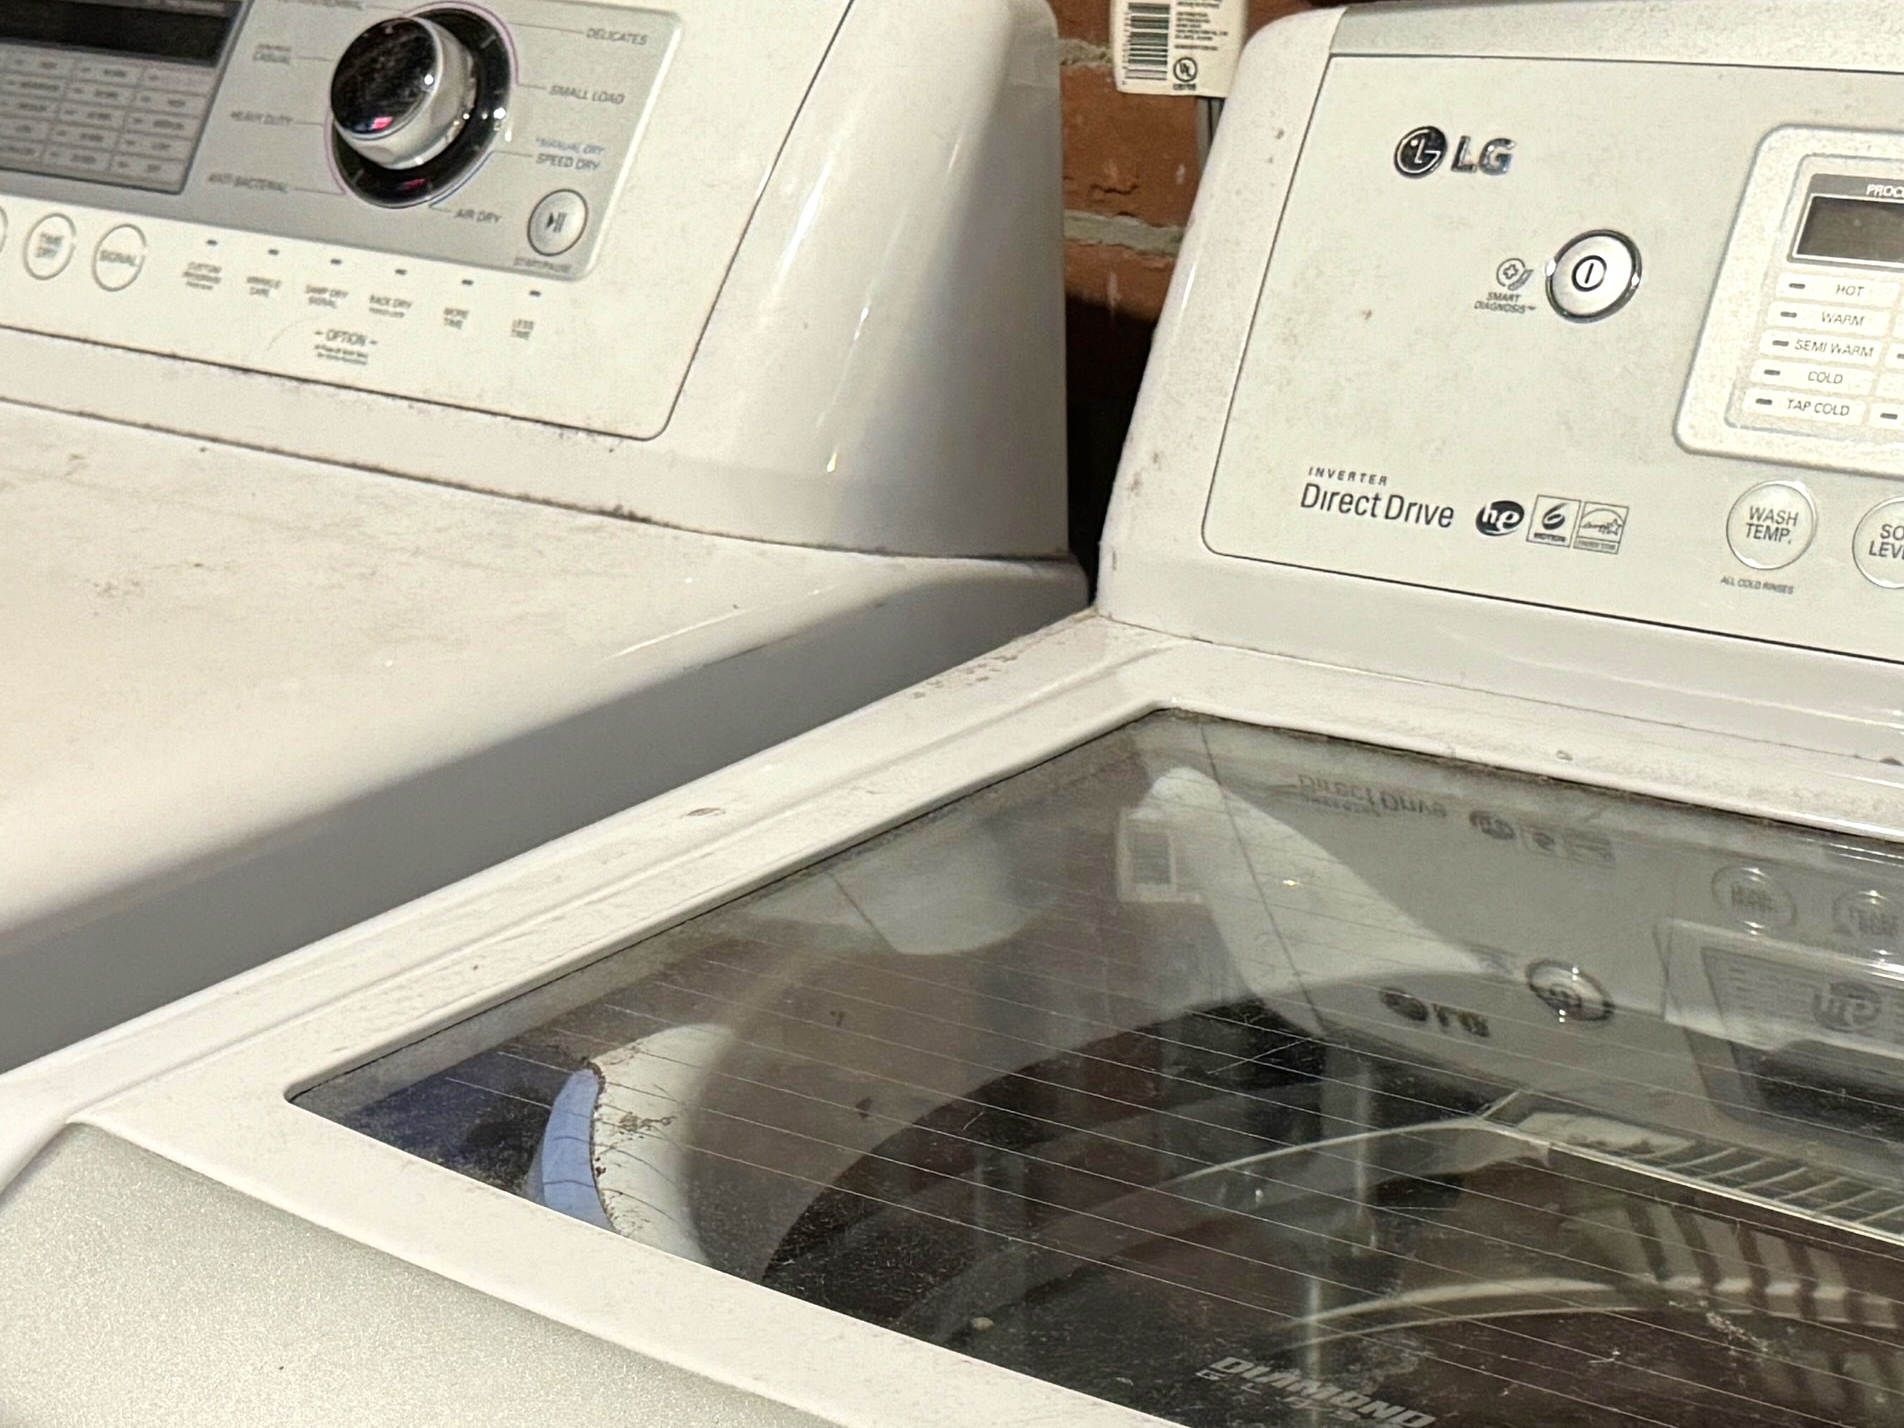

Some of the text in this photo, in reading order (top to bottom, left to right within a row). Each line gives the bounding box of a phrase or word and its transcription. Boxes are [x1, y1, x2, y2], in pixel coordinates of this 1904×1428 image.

[586, 27, 647, 46] DELICATES
[549, 84, 625, 105] SMALL LOAD
[535, 153, 602, 172] SPEED DRY
[454, 208, 503, 224] AIR DRY
[1836, 284, 1865, 297] HOT
[1821, 311, 1865, 327] WARM
[1794, 339, 1874, 358] SEMI WARM
[1807, 371, 1844, 385] COLD
[1786, 398, 1850, 417] TAP COLD
[1308, 466, 1388, 486] INVERTER
[1300, 483, 1454, 529] Direct Drive
[1747, 505, 1799, 527] WASH
[1745, 523, 1793, 545] TEMP.
[1210, 1356, 1436, 1428] DIAMOND
